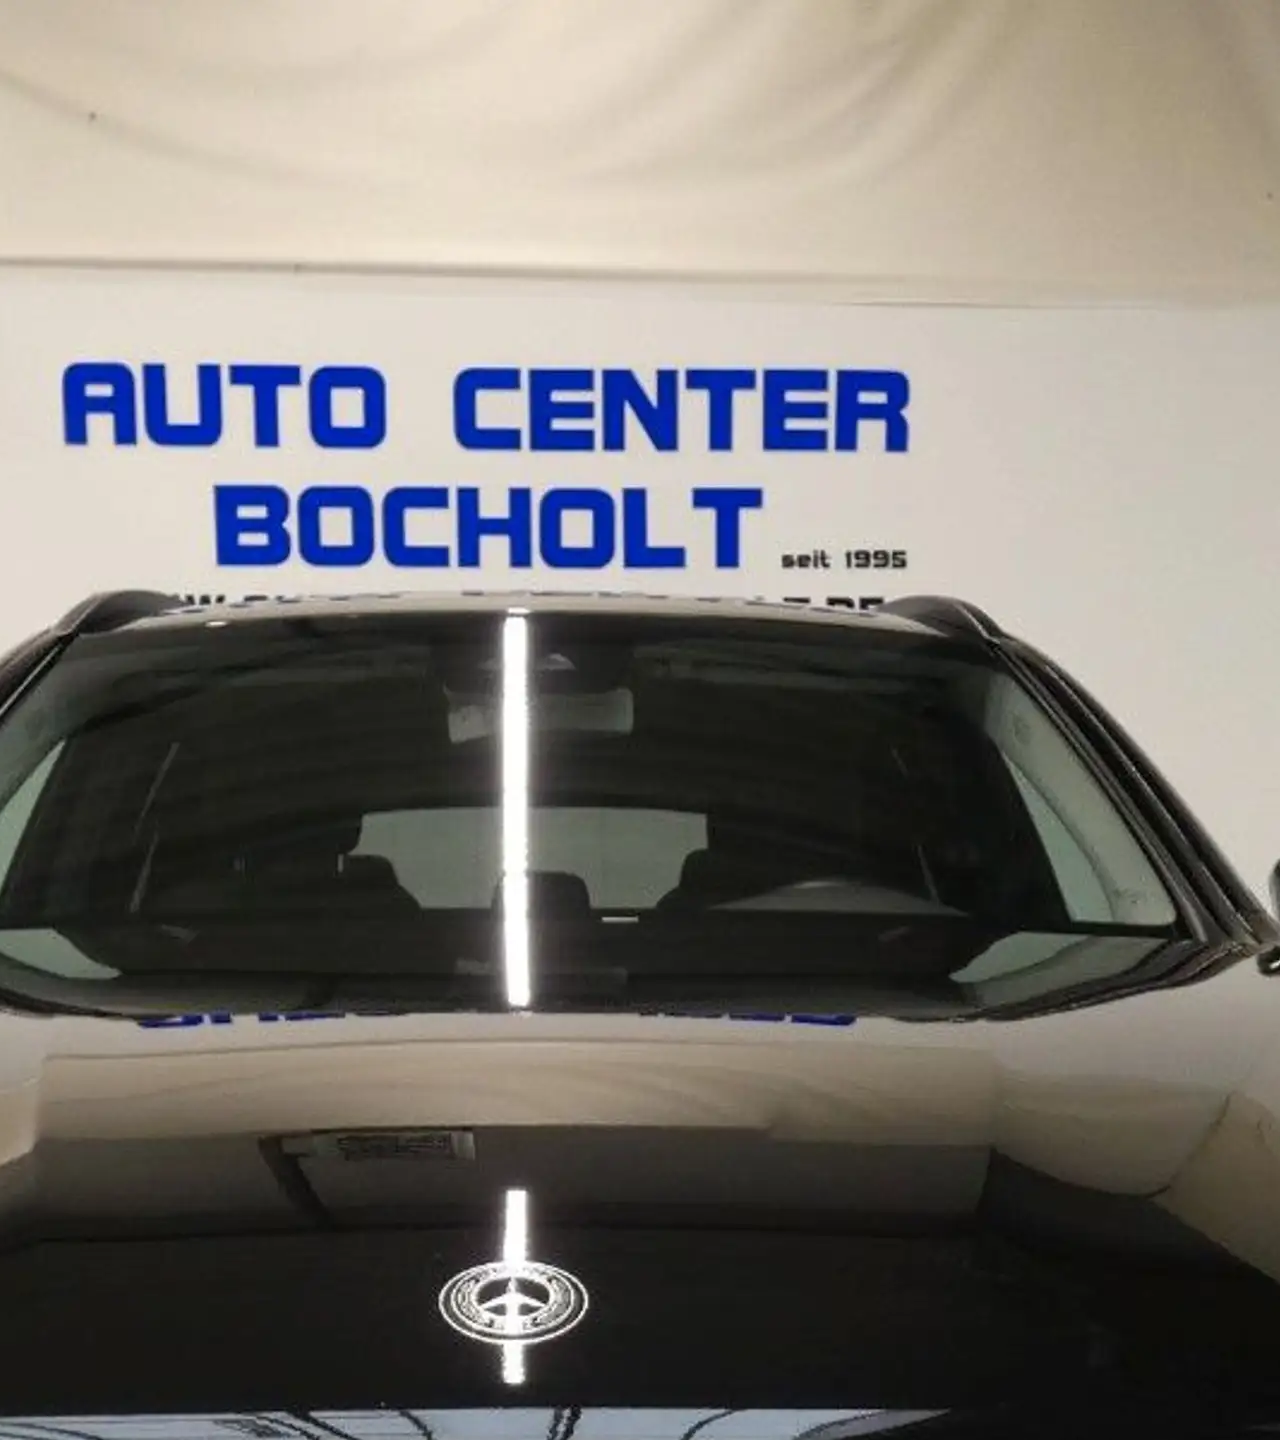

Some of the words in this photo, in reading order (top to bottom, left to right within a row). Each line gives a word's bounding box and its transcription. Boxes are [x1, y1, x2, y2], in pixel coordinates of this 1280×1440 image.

[61, 361, 389, 450] AUTO
[452, 366, 911, 454] CENTER
[213, 483, 765, 571] BOCHOLT
[780, 548, 832, 569] seit
[844, 549, 908, 569] 1995
